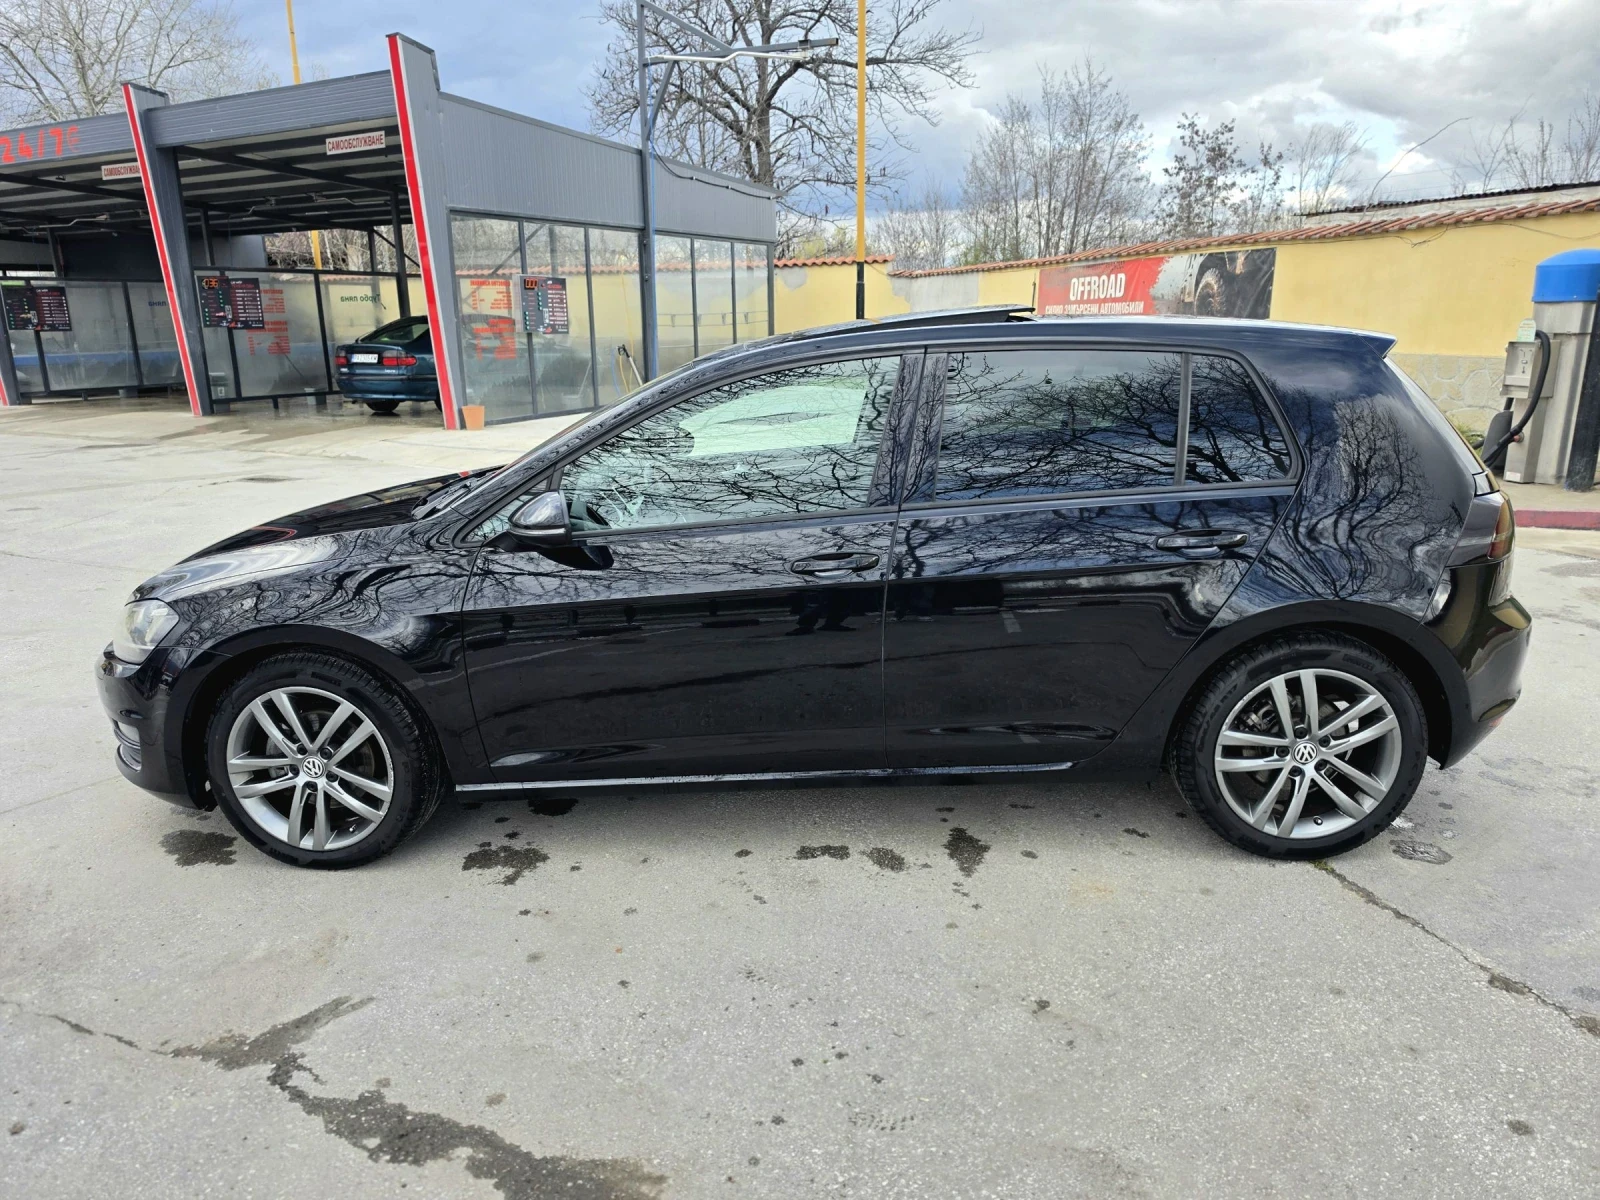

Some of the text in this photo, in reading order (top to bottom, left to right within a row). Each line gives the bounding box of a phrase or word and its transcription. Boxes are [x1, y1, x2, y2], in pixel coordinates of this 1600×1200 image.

[327, 134, 384, 152] САМООБСЛУЖВАНЕ
[1069, 272, 1126, 301] OFFROAD
[1064, 303, 1099, 315] ЗАМЪРСЕНИ
[1100, 301, 1144, 314] АВТОМОБИЛИ
